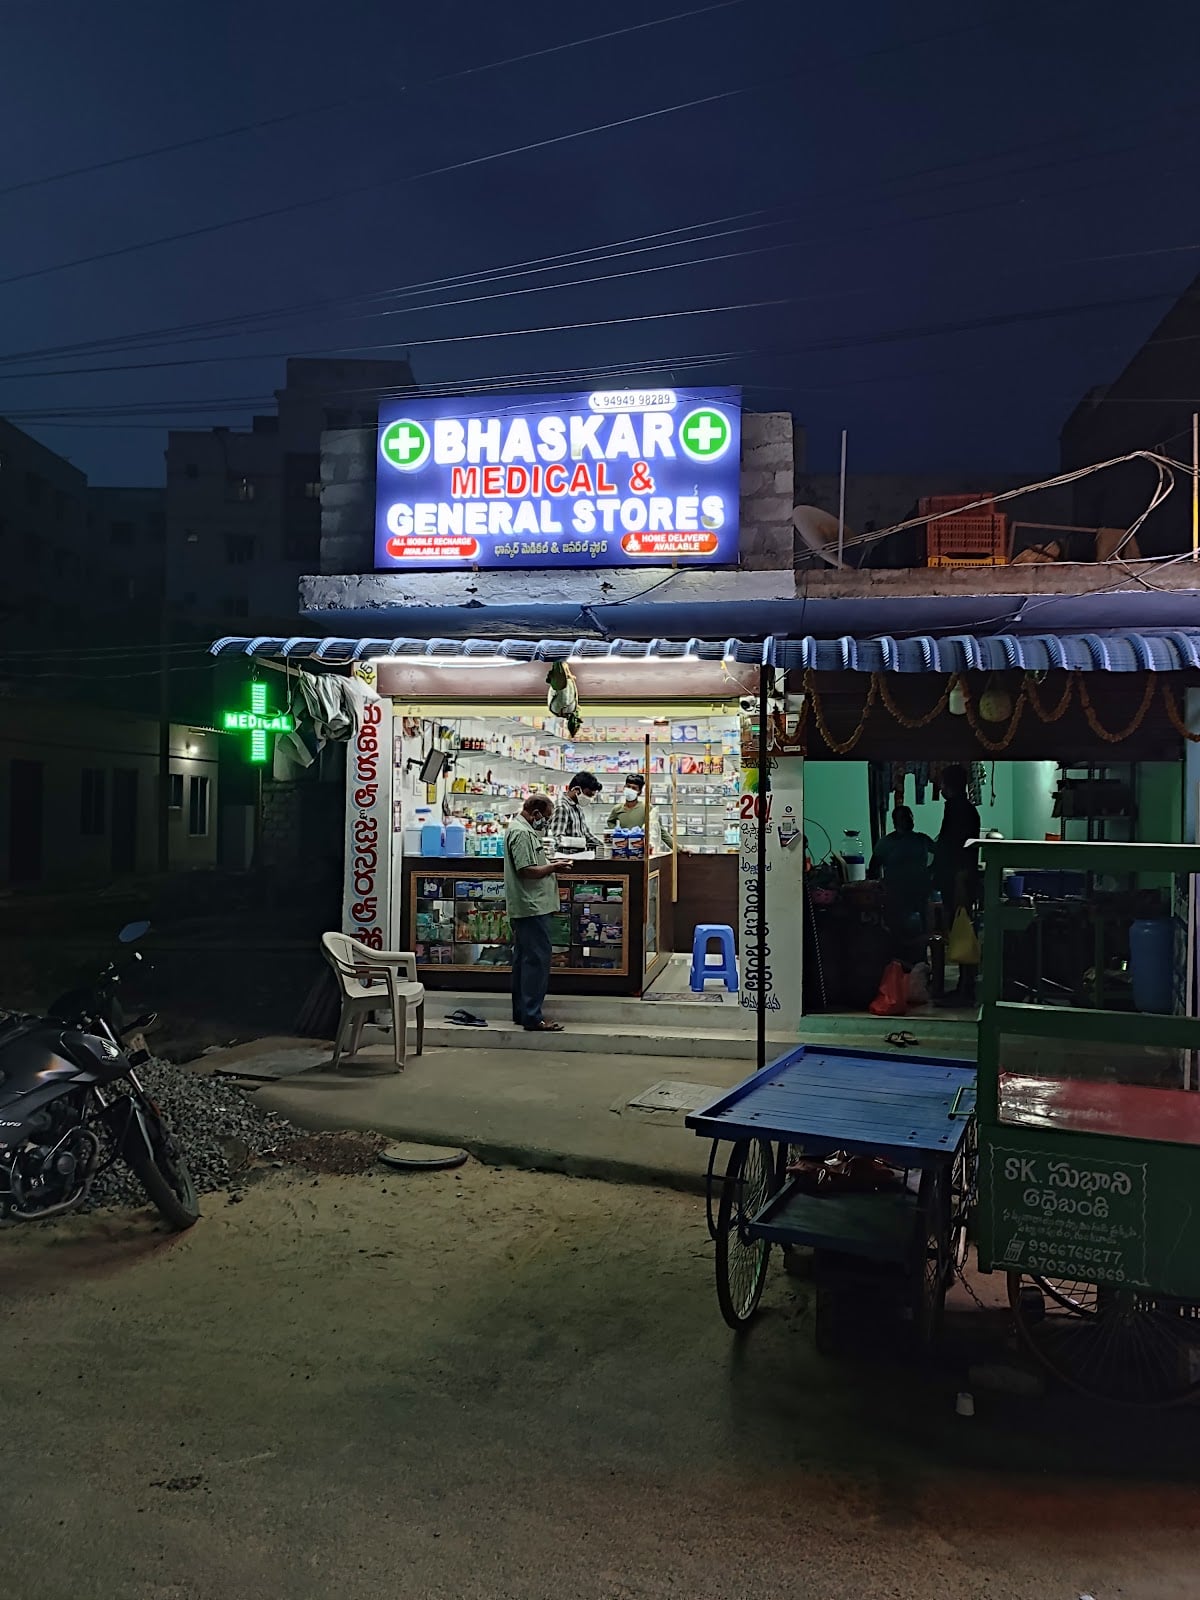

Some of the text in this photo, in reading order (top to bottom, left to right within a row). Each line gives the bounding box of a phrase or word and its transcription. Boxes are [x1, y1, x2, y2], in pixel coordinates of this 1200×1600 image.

[603, 394, 671, 406] 94949 98289
[434, 412, 677, 464] BHASKAR
[451, 460, 655, 498] MEDICAL &
[386, 495, 725, 536] GENERAL STORES
[392, 537, 472, 546] ALL MOBILE RECHARGE
[641, 533, 711, 543] HOME DELIVERY
[402, 547, 440, 556] AVAILABLE
[550, 541, 561, 554] &
[653, 542, 700, 551] AVAILABLE
[224, 712, 292, 731] MEDICAL
